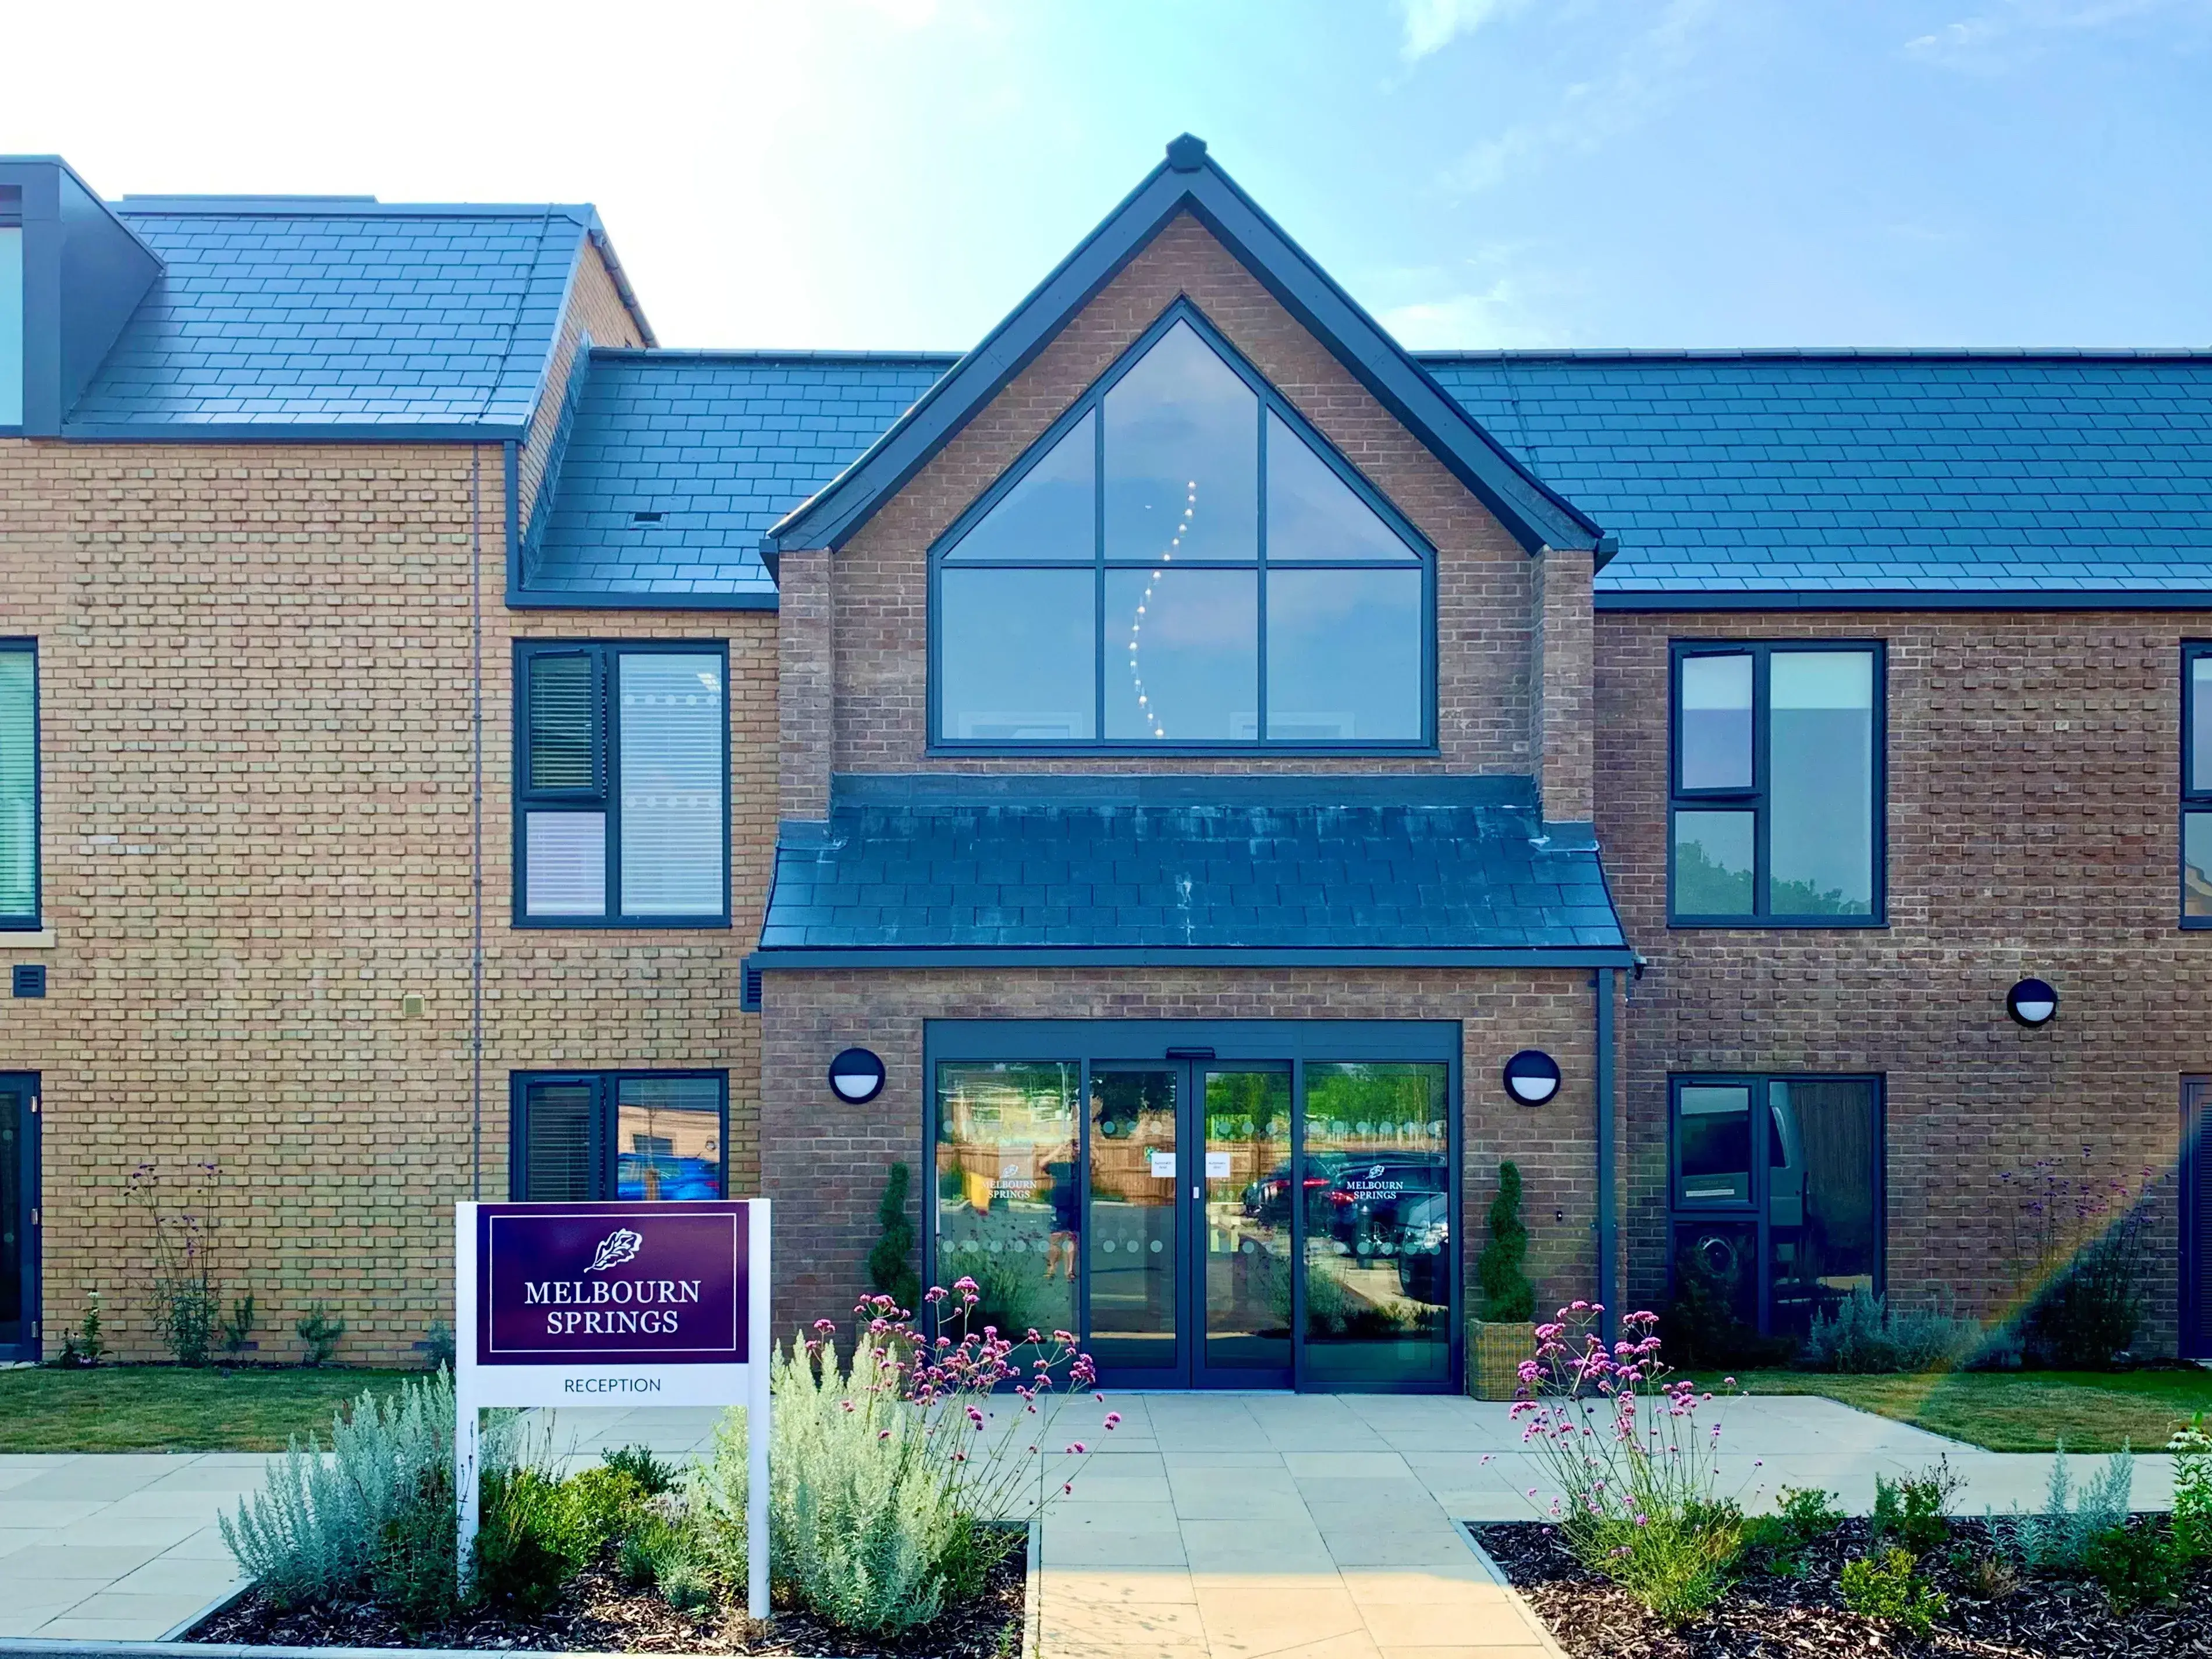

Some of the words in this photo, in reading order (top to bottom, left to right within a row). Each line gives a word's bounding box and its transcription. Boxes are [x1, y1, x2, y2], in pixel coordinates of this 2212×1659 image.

[1347, 1181, 1403, 1189] MELBOURN
[989, 1190, 1030, 1199] SPRINGS
[1354, 1191, 1397, 1199] SPRINGS
[524, 1280, 701, 1304] MELBOURN
[546, 1310, 678, 1334] SPRINGS
[564, 1378, 661, 1392] RECEPTION
